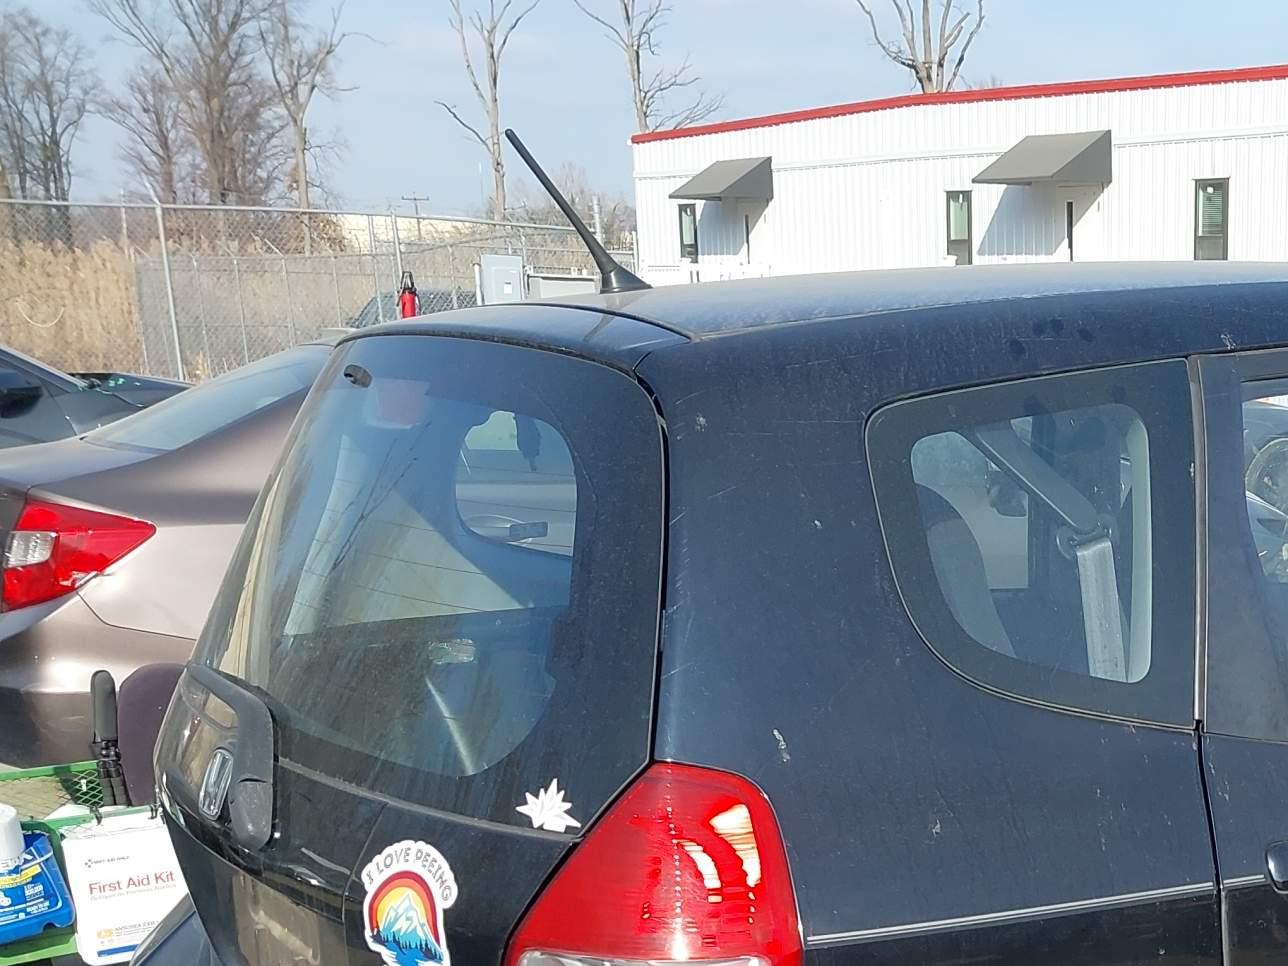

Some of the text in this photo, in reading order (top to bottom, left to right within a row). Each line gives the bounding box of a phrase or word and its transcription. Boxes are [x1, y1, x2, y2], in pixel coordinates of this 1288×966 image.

[88, 879, 123, 895] First
[126, 874, 151, 889] Aid
[154, 871, 176, 885] Kit
[366, 847, 453, 901] I LOVE PEEING
